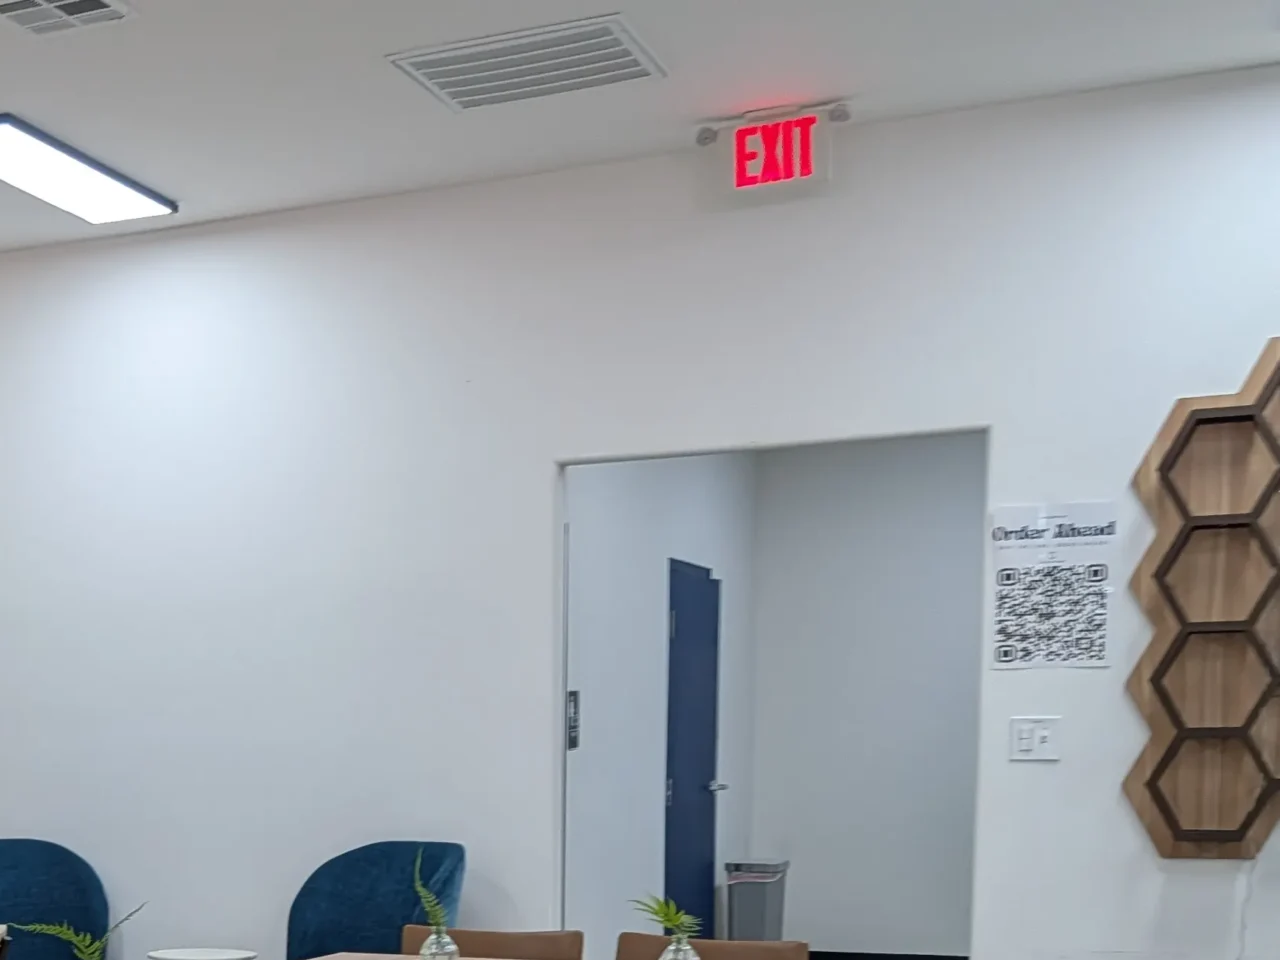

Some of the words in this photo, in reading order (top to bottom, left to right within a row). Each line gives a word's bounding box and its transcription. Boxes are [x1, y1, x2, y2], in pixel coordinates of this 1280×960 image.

[735, 116, 817, 188] EXIT
[992, 525, 1050, 541] Order
[1052, 520, 1116, 539] Ahead
